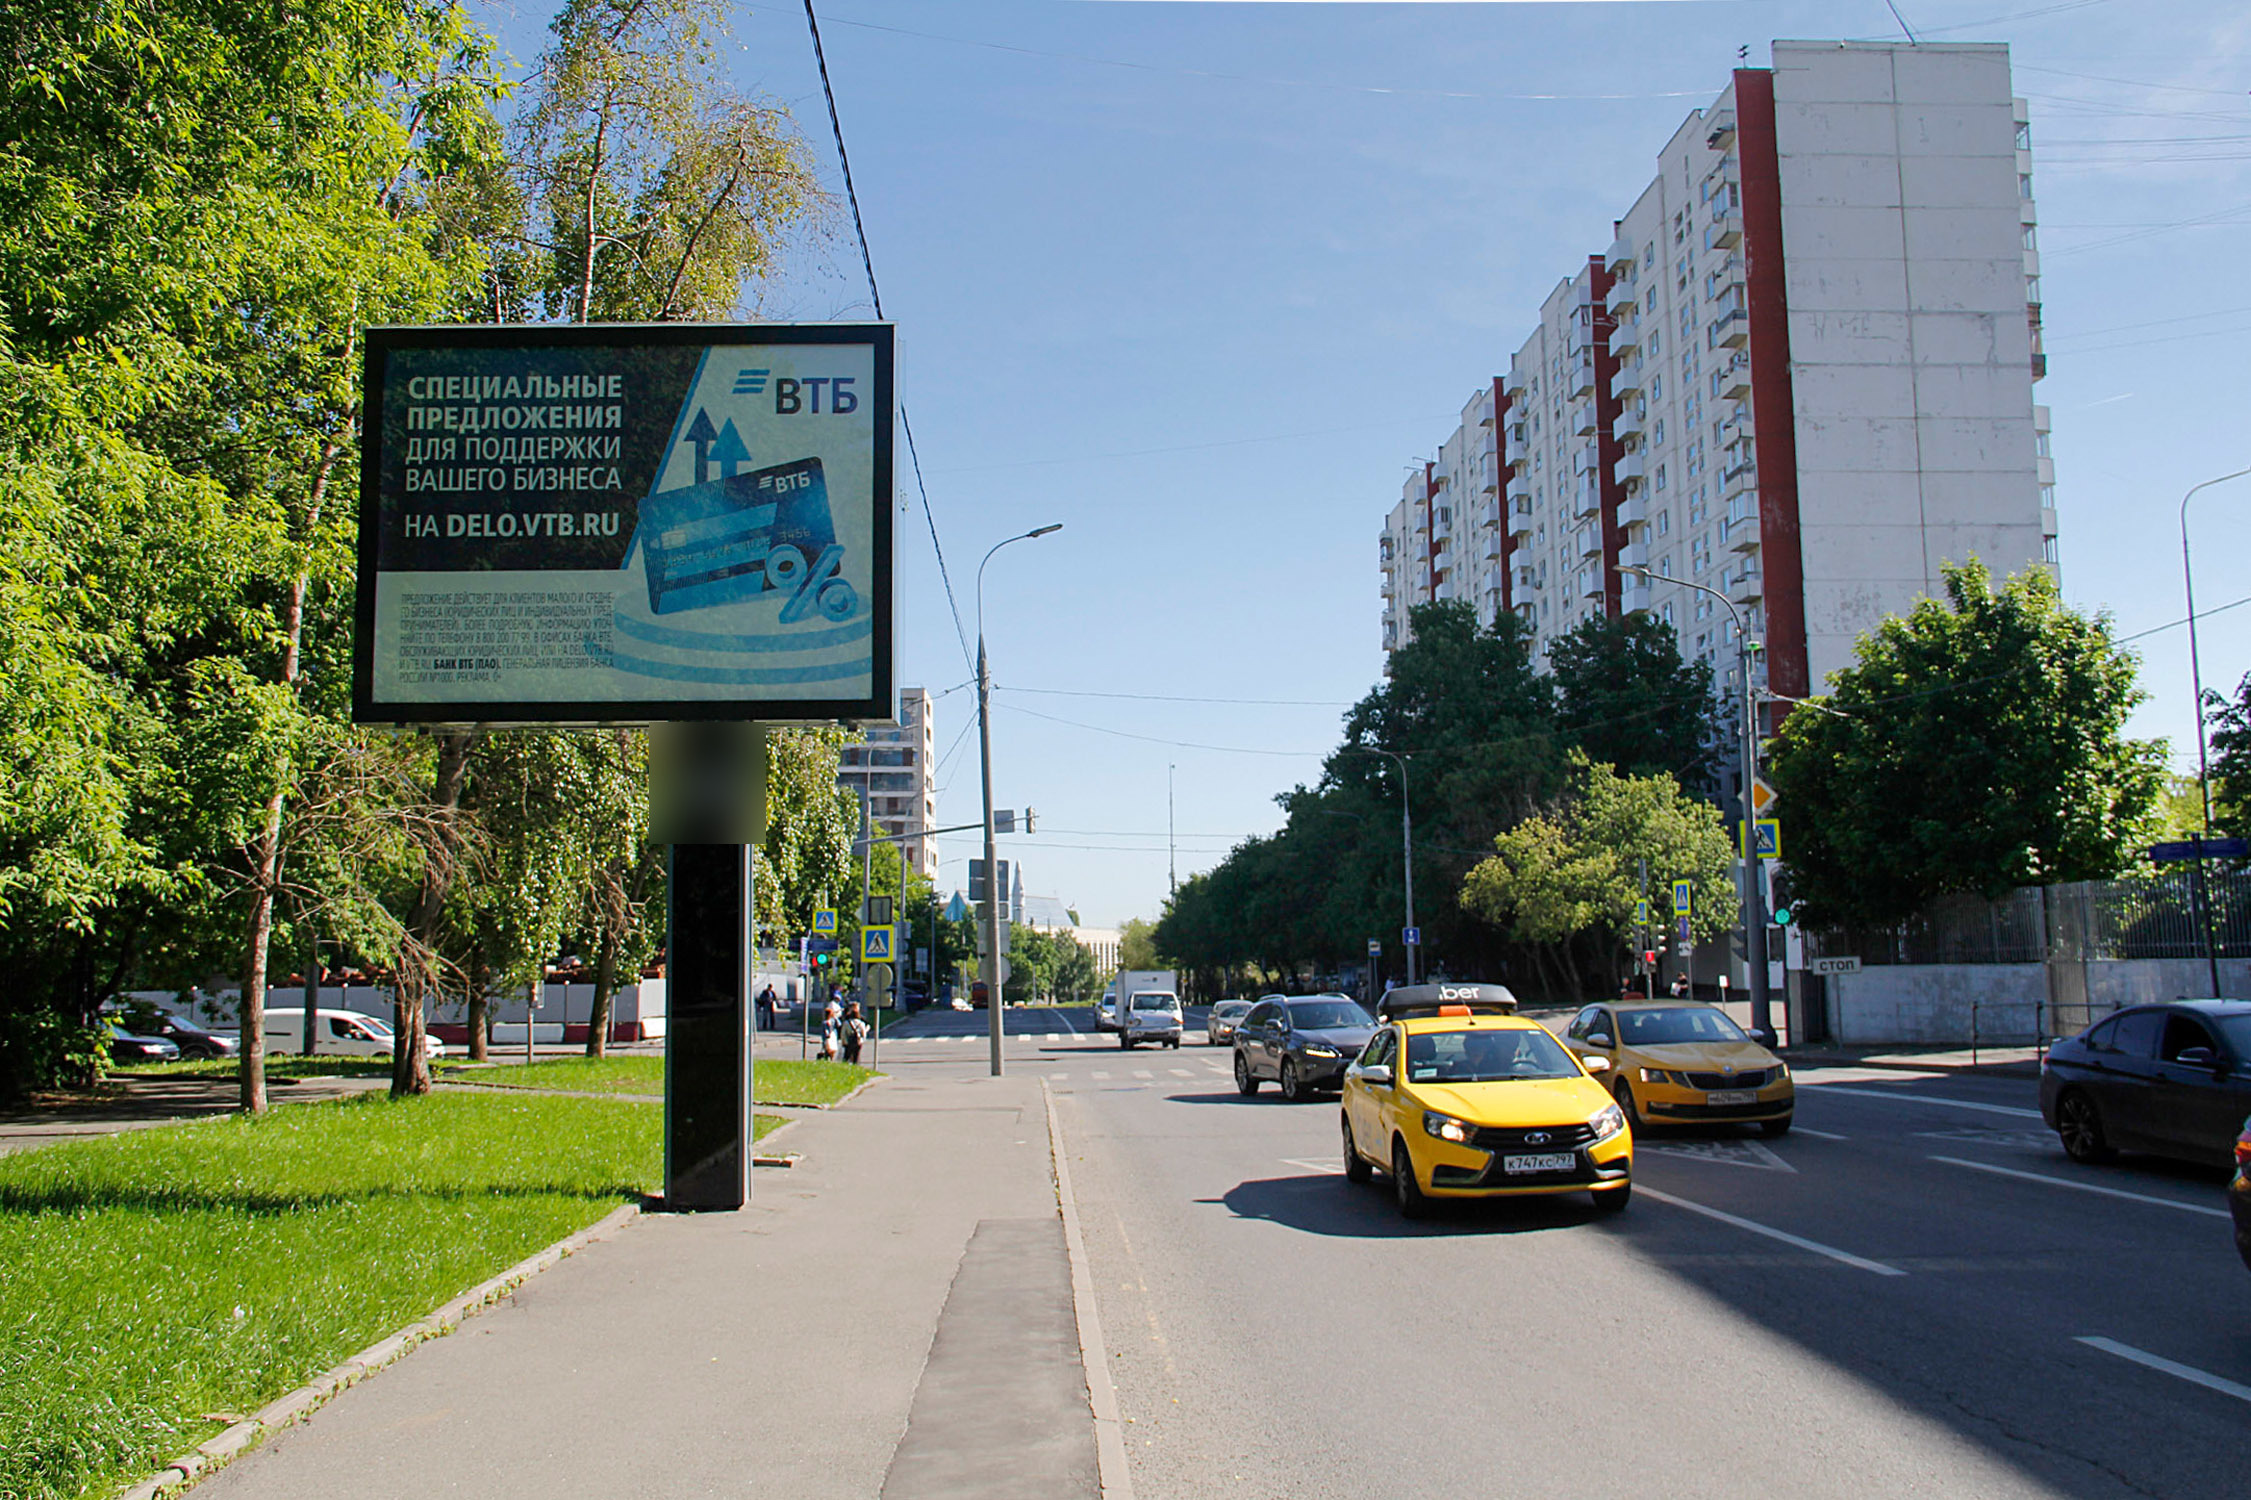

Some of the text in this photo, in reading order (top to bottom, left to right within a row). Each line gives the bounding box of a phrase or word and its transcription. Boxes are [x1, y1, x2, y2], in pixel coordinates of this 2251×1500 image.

[408, 376, 623, 404] СПЕЦИАЛЬНЫЕ
[775, 376, 859, 414] ВТБ
[407, 405, 622, 434] ПРЕДЛОЖЕНИЯ
[405, 436, 621, 465] ДЛЯ ПОДДЕРЖКИ
[405, 467, 622, 492] ВАШЕГО БИЗНЕСА
[775, 469, 811, 494] ВТБ
[405, 512, 620, 538] НА DELO.VTB.RU
[434, 658, 457, 669] БАНК
[459, 658, 474, 669] ВТБ
[1819, 959, 1855, 972] СТОП
